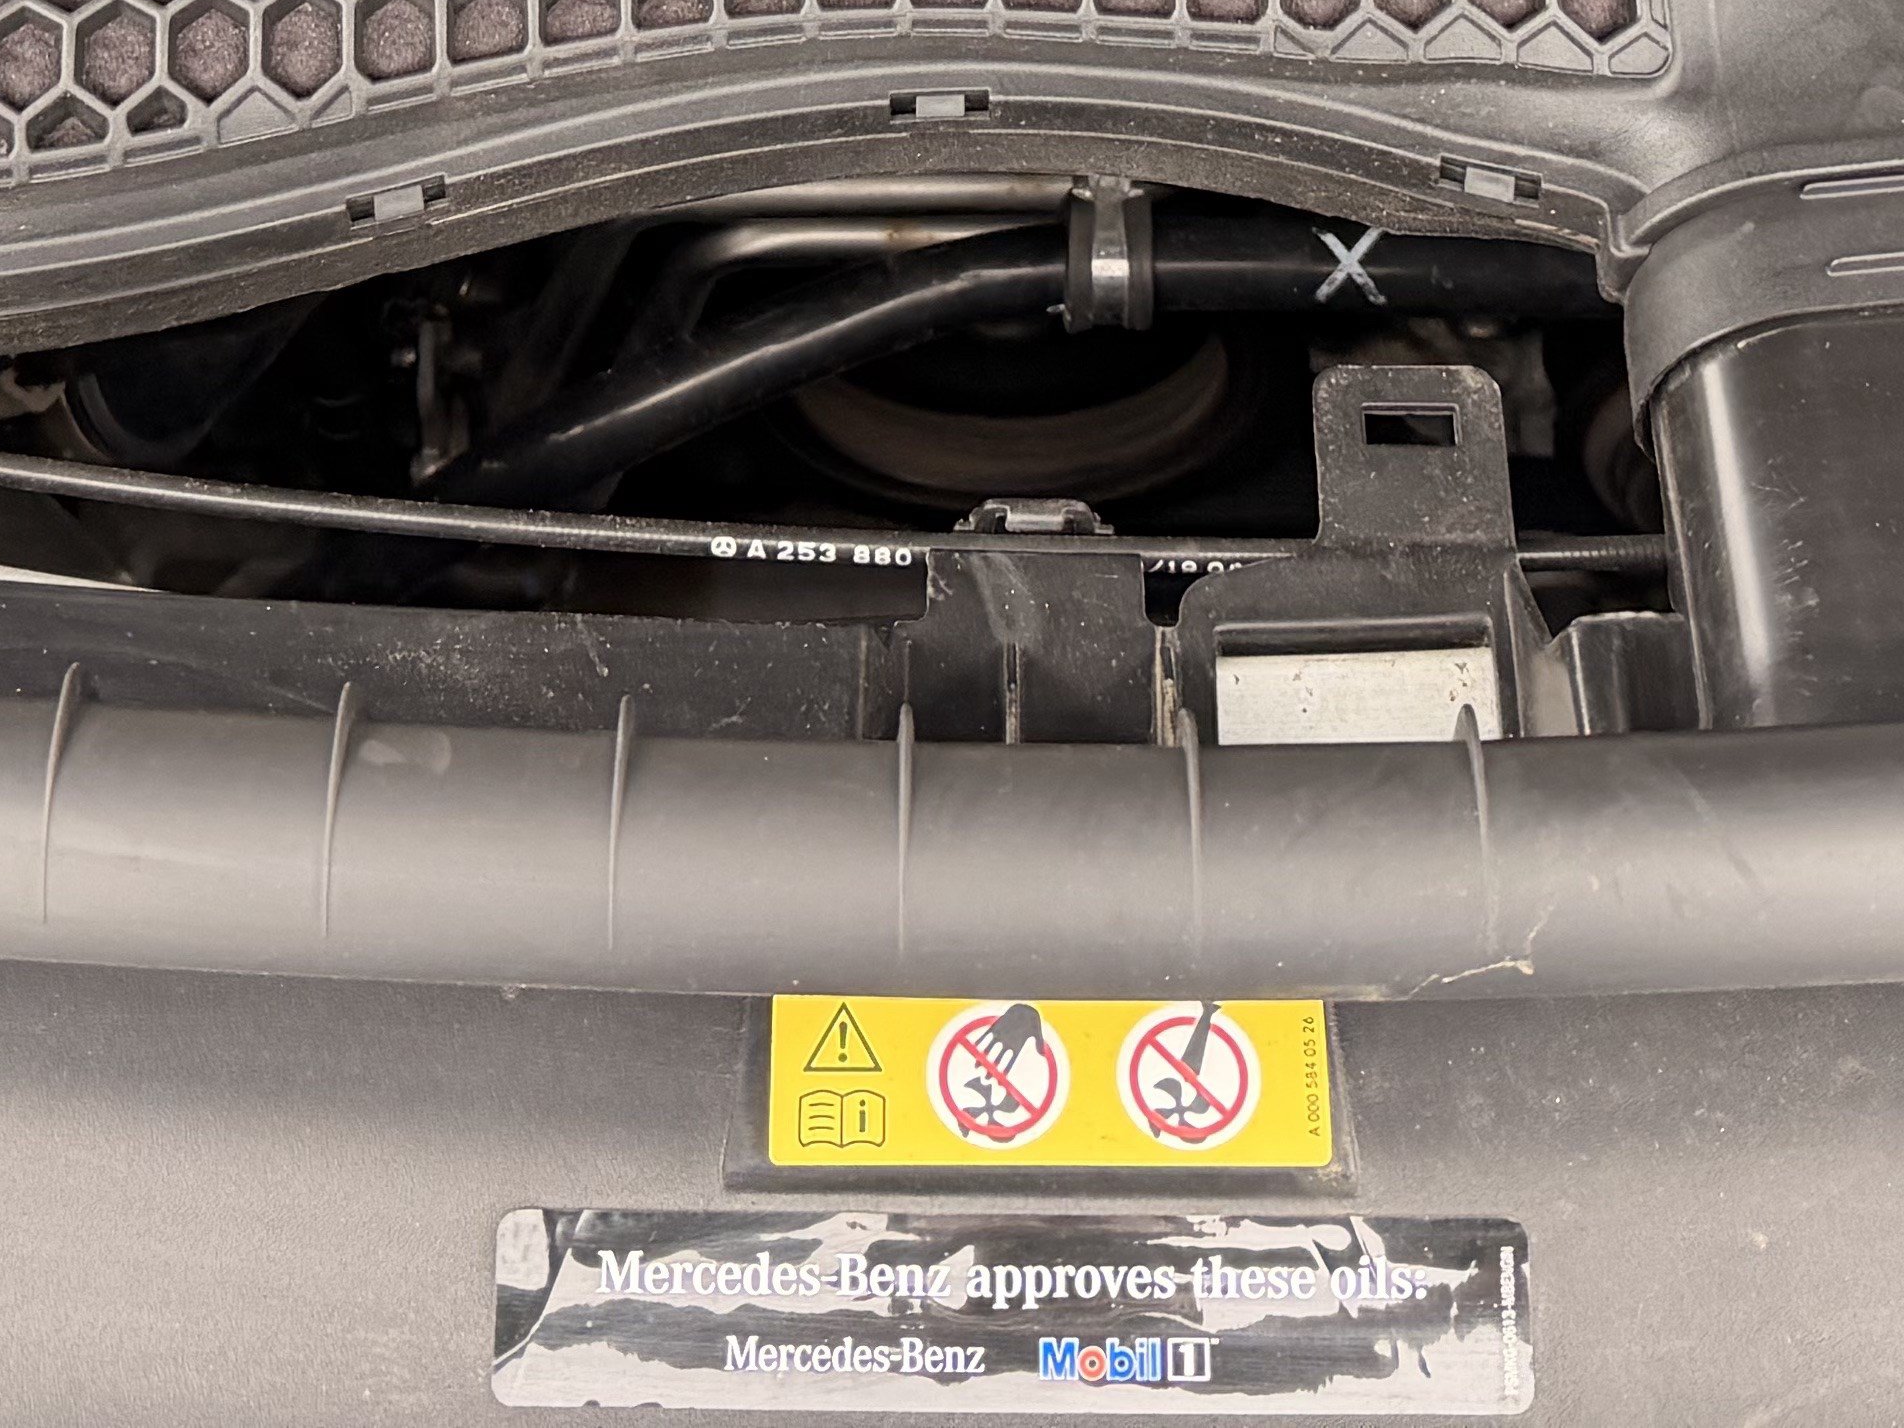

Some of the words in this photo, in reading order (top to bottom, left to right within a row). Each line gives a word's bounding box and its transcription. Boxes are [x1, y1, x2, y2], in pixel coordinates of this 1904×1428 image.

[747, 539, 769, 561] A
[777, 541, 837, 564] 253
[853, 545, 912, 568] 880
[1302, 1016, 1315, 1033] 26
[1303, 1039, 1317, 1057] 05
[1305, 1062, 1318, 1089] 584
[1306, 1093, 1321, 1123] 000
[1308, 1126, 1320, 1137] A
[595, 1248, 953, 1298] Mercedes-Benz
[965, 1262, 1176, 1310] approves
[1193, 1255, 1317, 1301] these
[1330, 1254, 1429, 1301] oils:
[723, 1334, 986, 1375] Mercedes-Benz
[1039, 1337, 1162, 1382] Mobil
